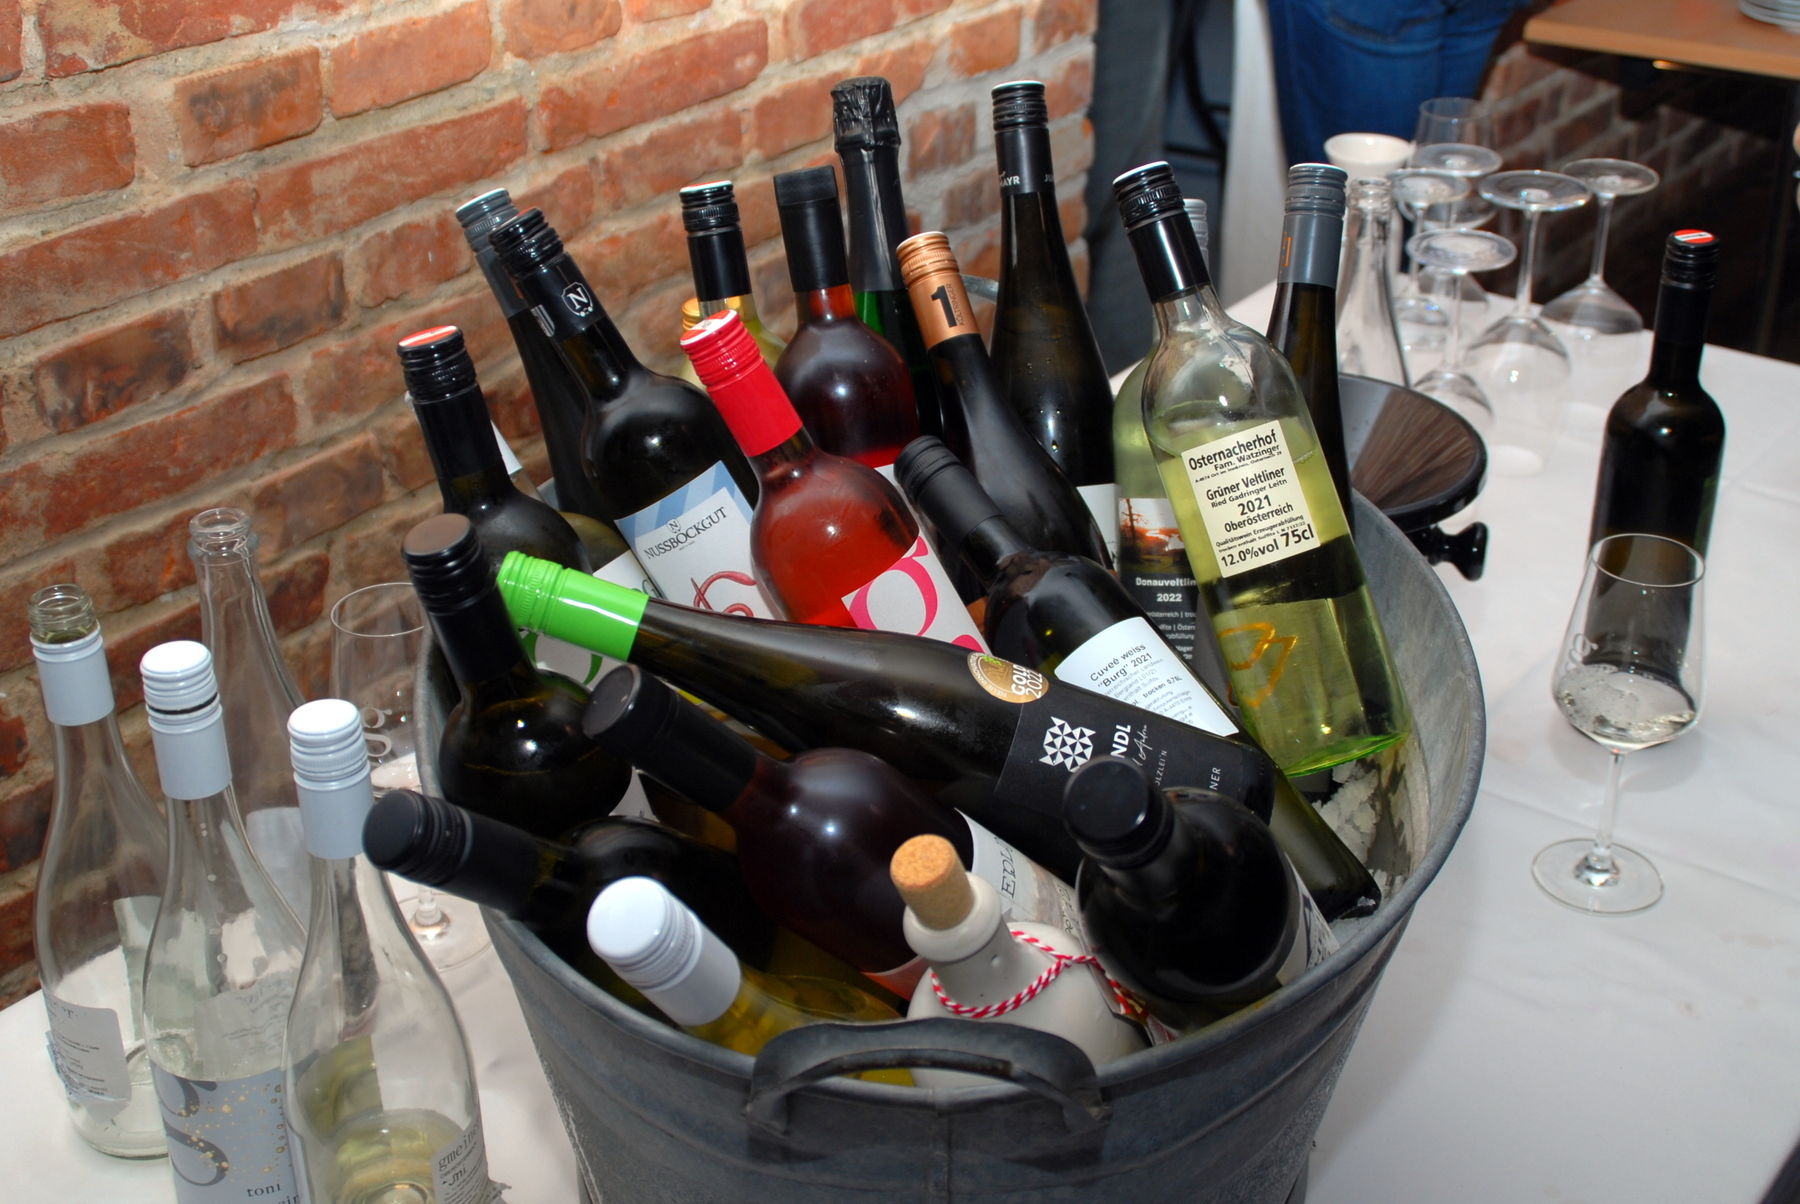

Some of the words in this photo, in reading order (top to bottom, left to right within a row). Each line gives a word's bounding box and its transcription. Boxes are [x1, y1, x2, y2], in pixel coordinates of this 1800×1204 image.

[567, 287, 589, 310] N
[930, 285, 958, 329] 1
[1188, 428, 1277, 471] Osternacherhof
[1213, 460, 1236, 471] Fam.
[1237, 444, 1280, 463] Watzinger
[1206, 481, 1240, 501] Grüner
[1241, 467, 1285, 489] Veltliner
[1210, 498, 1227, 509] Ried
[1228, 485, 1267, 502] Gadringer
[1268, 479, 1288, 489] Leitn
[1224, 502, 1294, 533] Oberösterreich
[1237, 494, 1272, 516] 2021
[1280, 523, 1315, 548] 75cl
[1156, 593, 1182, 602] 2022
[1120, 644, 1147, 661] weiss
[1130, 652, 1153, 668] 2021
[1109, 724, 1132, 759] NDL
[1208, 767, 1222, 791] NER
[246, 1184, 281, 1198] toni
